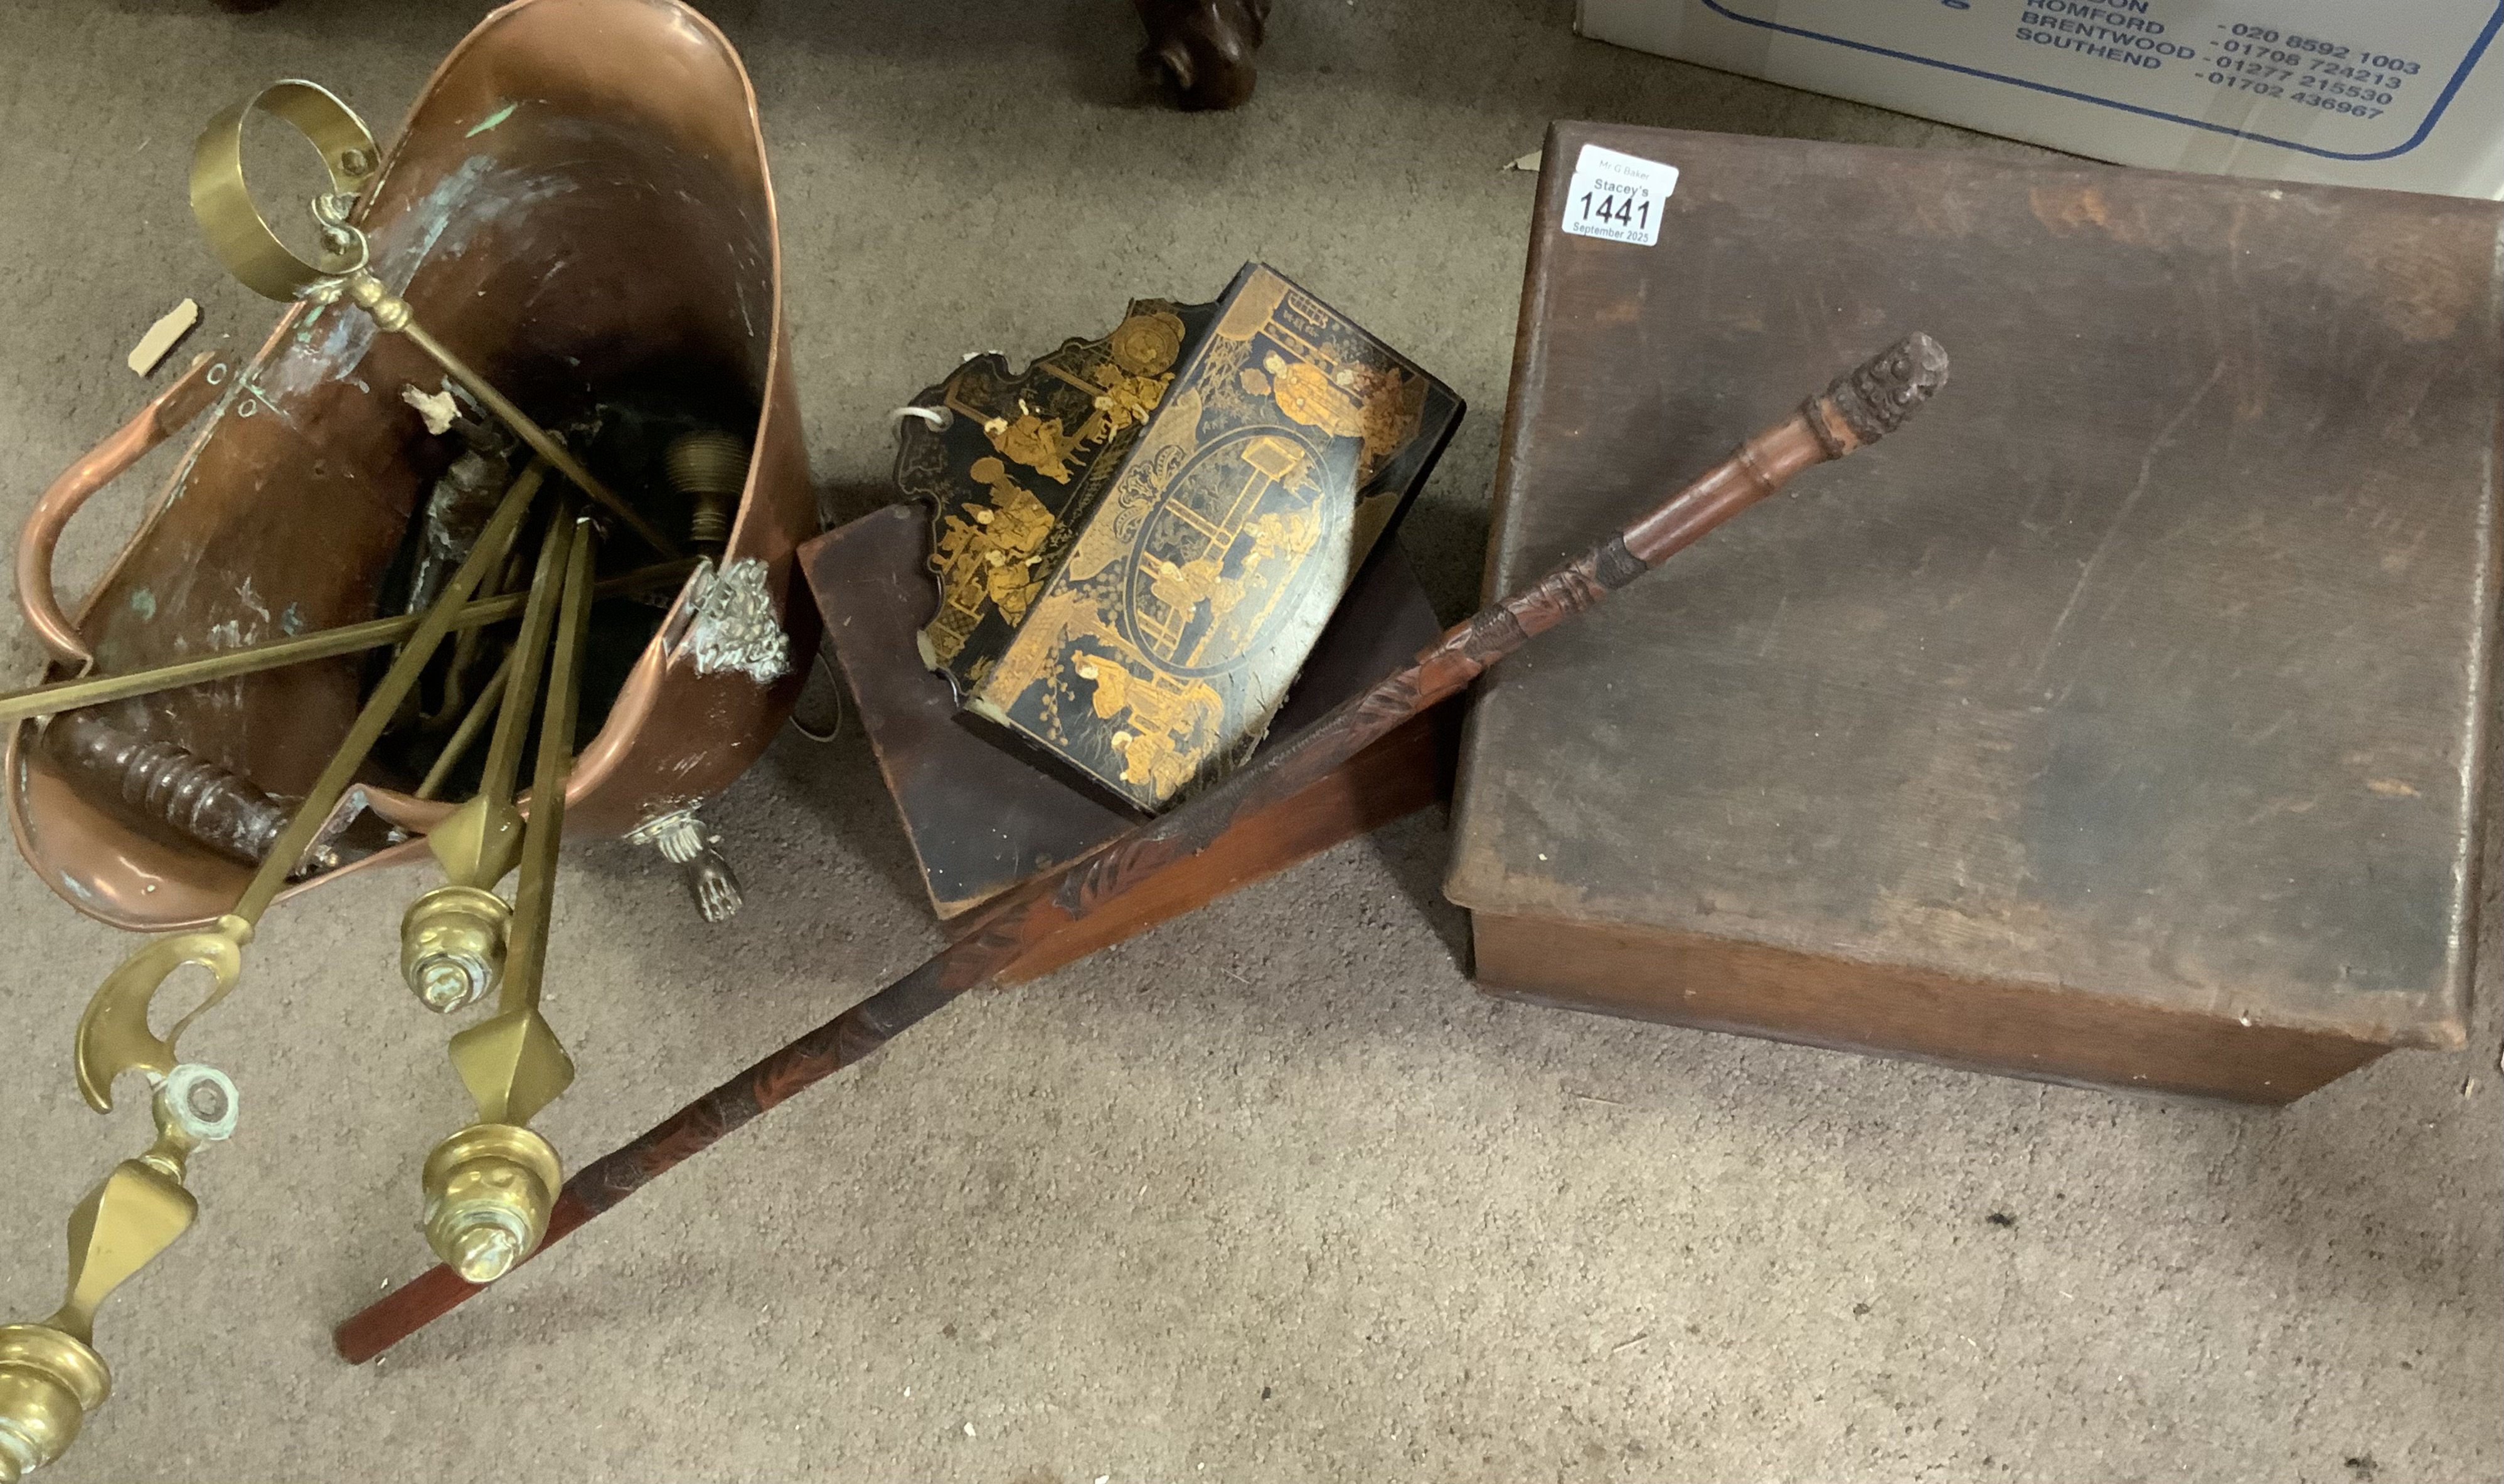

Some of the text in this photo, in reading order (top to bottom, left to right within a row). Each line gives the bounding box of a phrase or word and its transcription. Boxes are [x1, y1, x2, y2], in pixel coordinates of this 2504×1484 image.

[2022, 11, 2195, 60] BRENTWOOD
[2298, 75, 2393, 105] 215530
[2286, 35, 2350, 60] 8592
[2361, 52, 2421, 75] 1003
[2016, 28, 2161, 69] SOUTHEND
[2290, 92, 2384, 119] 436967
[2310, 58, 2402, 89] 724213
[1599, 160, 1650, 180] Mr G Baker
[1594, 179, 1649, 198] Stacey's
[1580, 191, 1650, 230] 1441
[1573, 221, 1649, 243] September 2025
